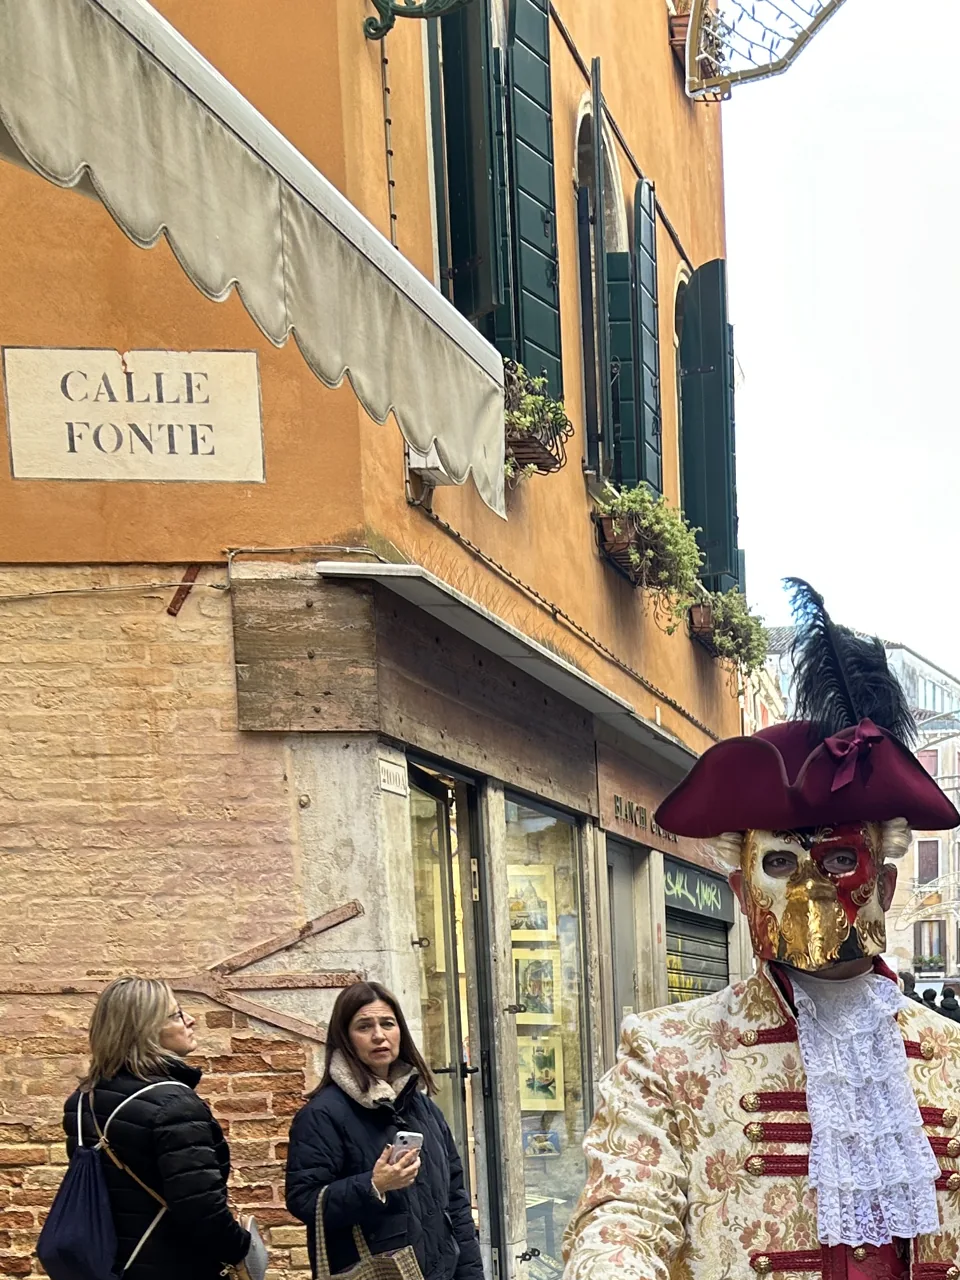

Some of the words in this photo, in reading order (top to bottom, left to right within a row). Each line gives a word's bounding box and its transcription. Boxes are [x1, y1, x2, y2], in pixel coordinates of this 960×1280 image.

[60, 370, 210, 404] CALLE
[64, 421, 216, 456] FONTE
[613, 794, 647, 831] BIANCHI
